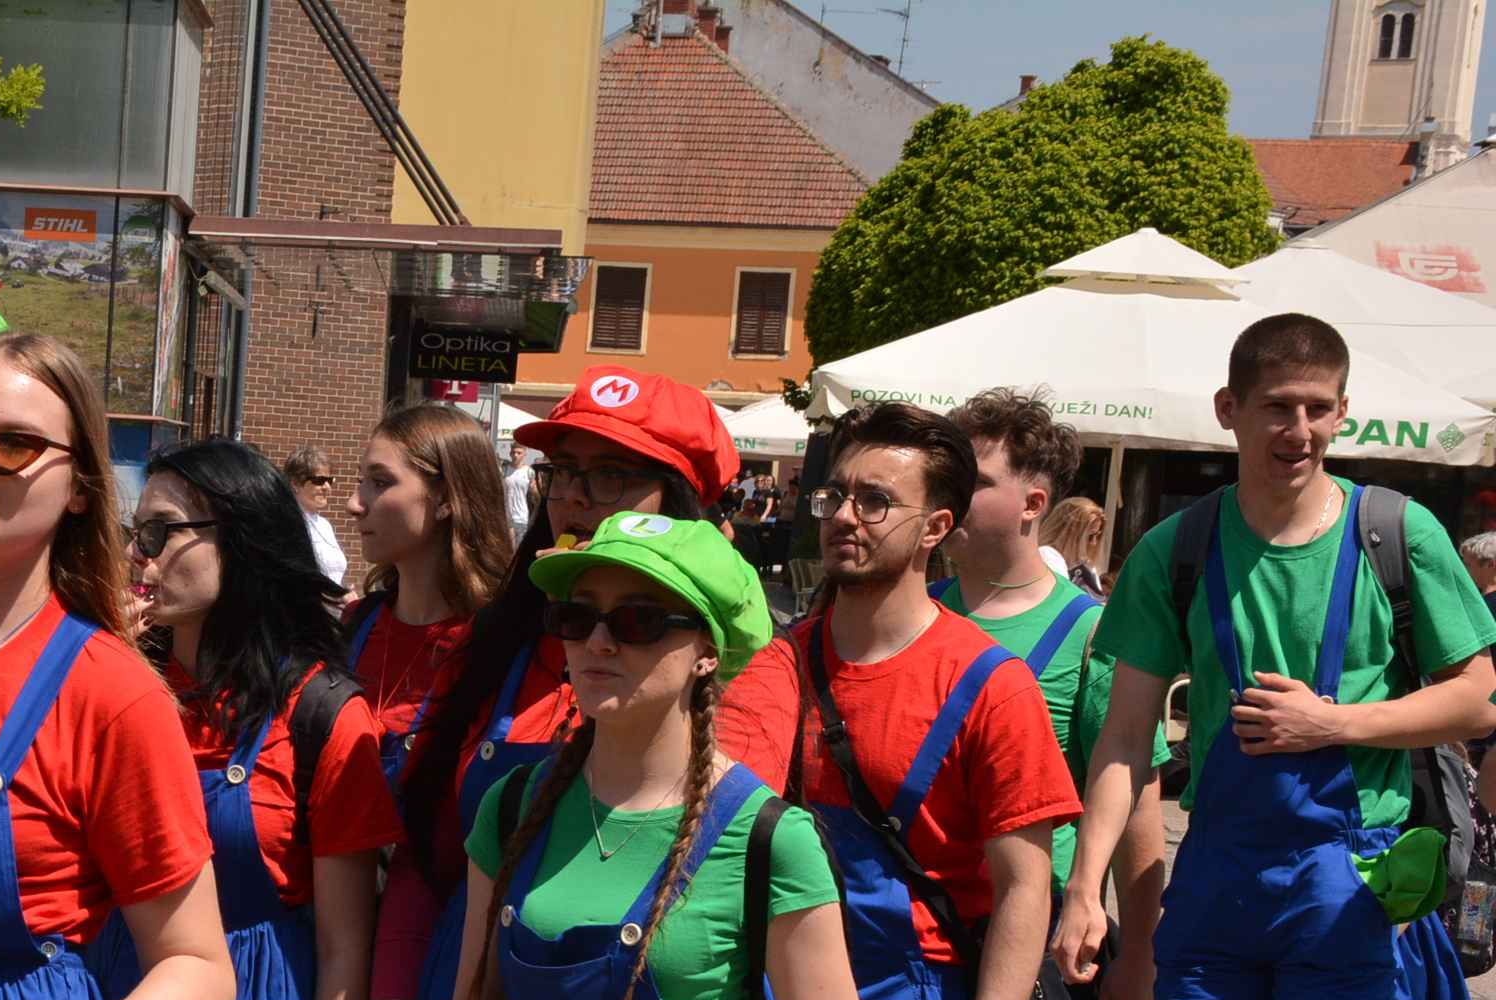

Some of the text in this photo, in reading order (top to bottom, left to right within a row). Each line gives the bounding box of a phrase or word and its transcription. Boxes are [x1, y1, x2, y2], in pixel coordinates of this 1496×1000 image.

[31, 216, 89, 233] STIHL
[420, 332, 511, 353] Optika
[417, 354, 508, 374] LINETA
[597, 379, 633, 403] M
[850, 389, 923, 404] POZOVI
[929, 393, 957, 407] NA
[1050, 400, 1098, 416] JEŽI
[1104, 403, 1153, 420] DAN!
[1330, 417, 1430, 449] PAN
